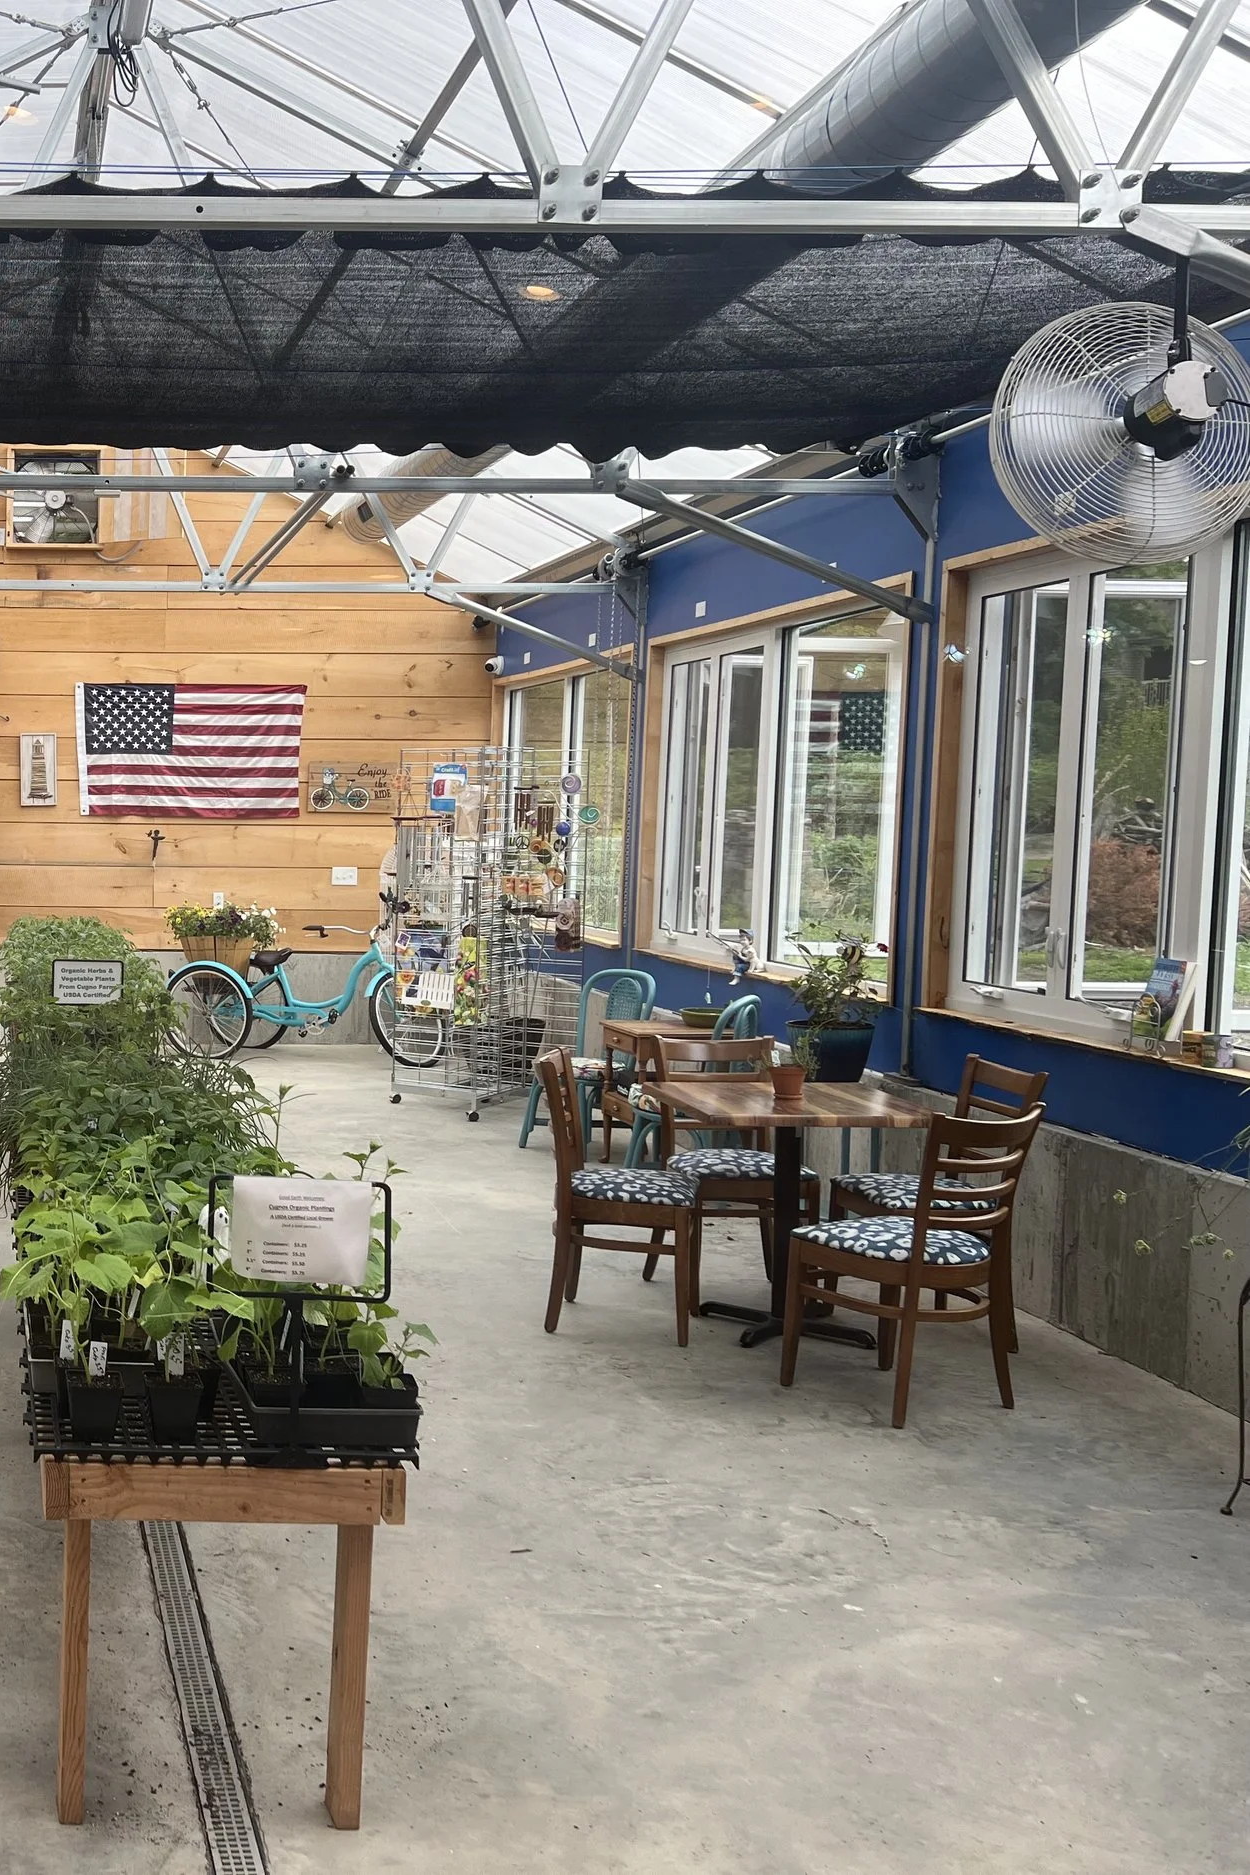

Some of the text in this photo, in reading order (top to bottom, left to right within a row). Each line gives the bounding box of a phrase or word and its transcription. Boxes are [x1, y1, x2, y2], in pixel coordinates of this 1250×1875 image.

[357, 763, 388, 779] Enjoy
[374, 777, 387, 788] the
[374, 789, 392, 799] RIDE
